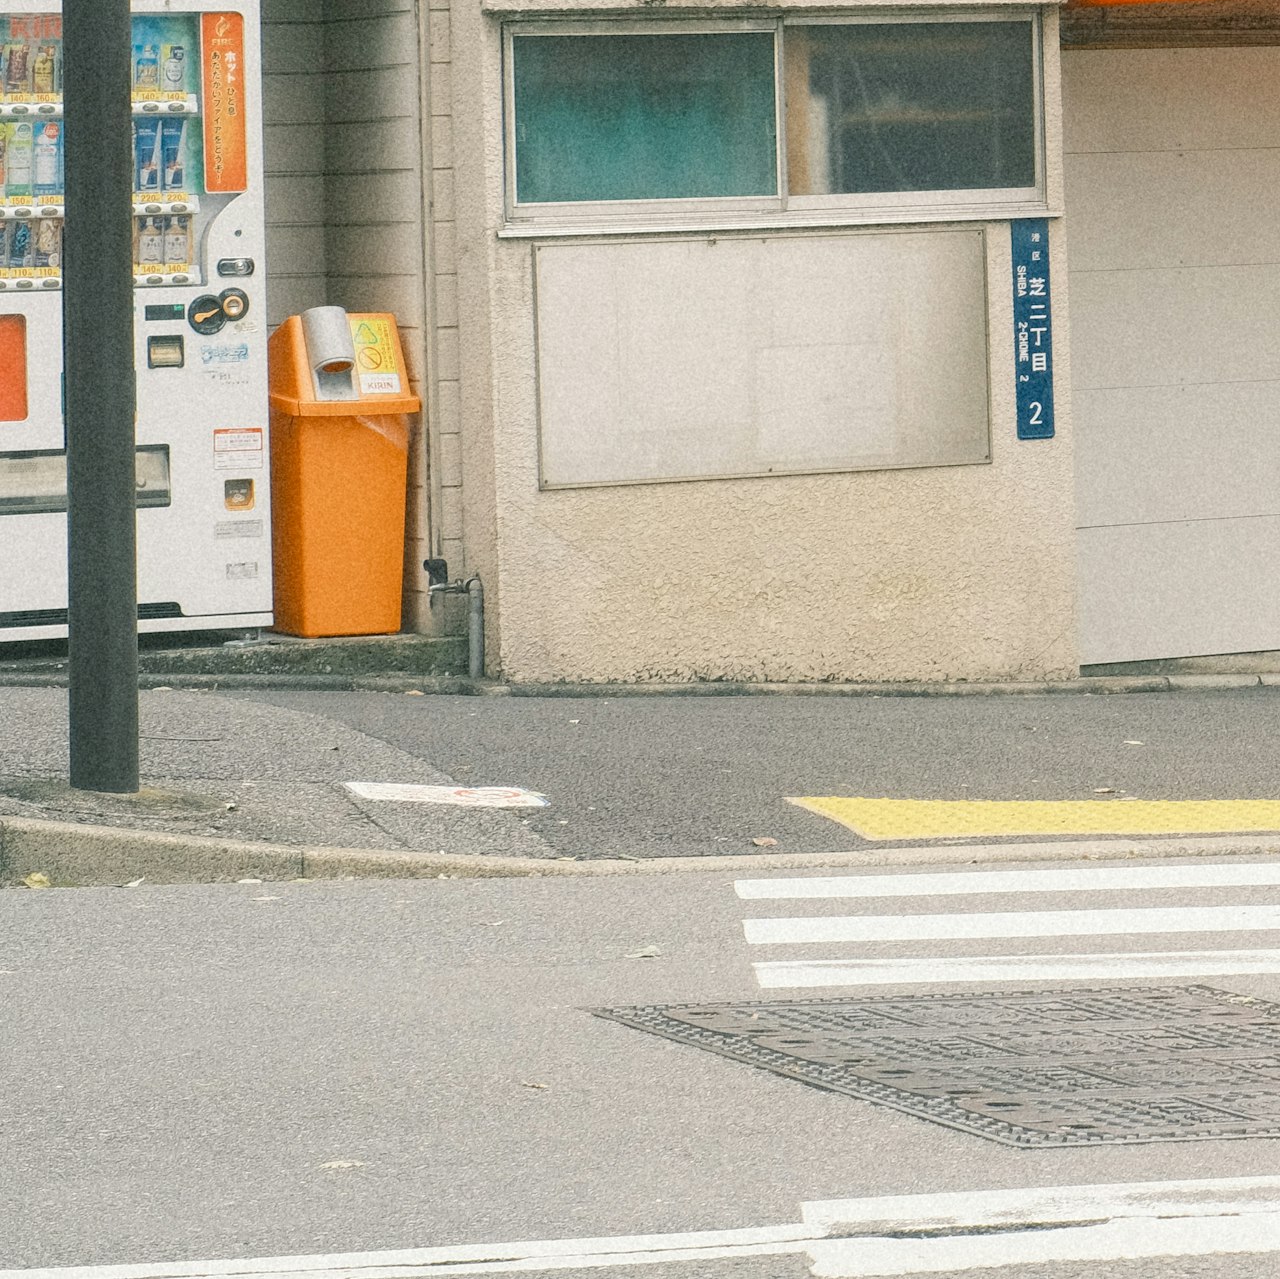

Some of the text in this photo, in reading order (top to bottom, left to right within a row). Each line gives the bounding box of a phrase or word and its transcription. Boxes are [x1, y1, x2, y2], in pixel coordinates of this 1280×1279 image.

[224, 51, 237, 83] ホット
[1017, 265, 1027, 297] SHIBA
[1029, 277, 1047, 372] 芝二丁目
[1018, 322, 1029, 362] 2-CHOME
[368, 382, 393, 390] KIRIN
[1029, 402, 1043, 425] 2
